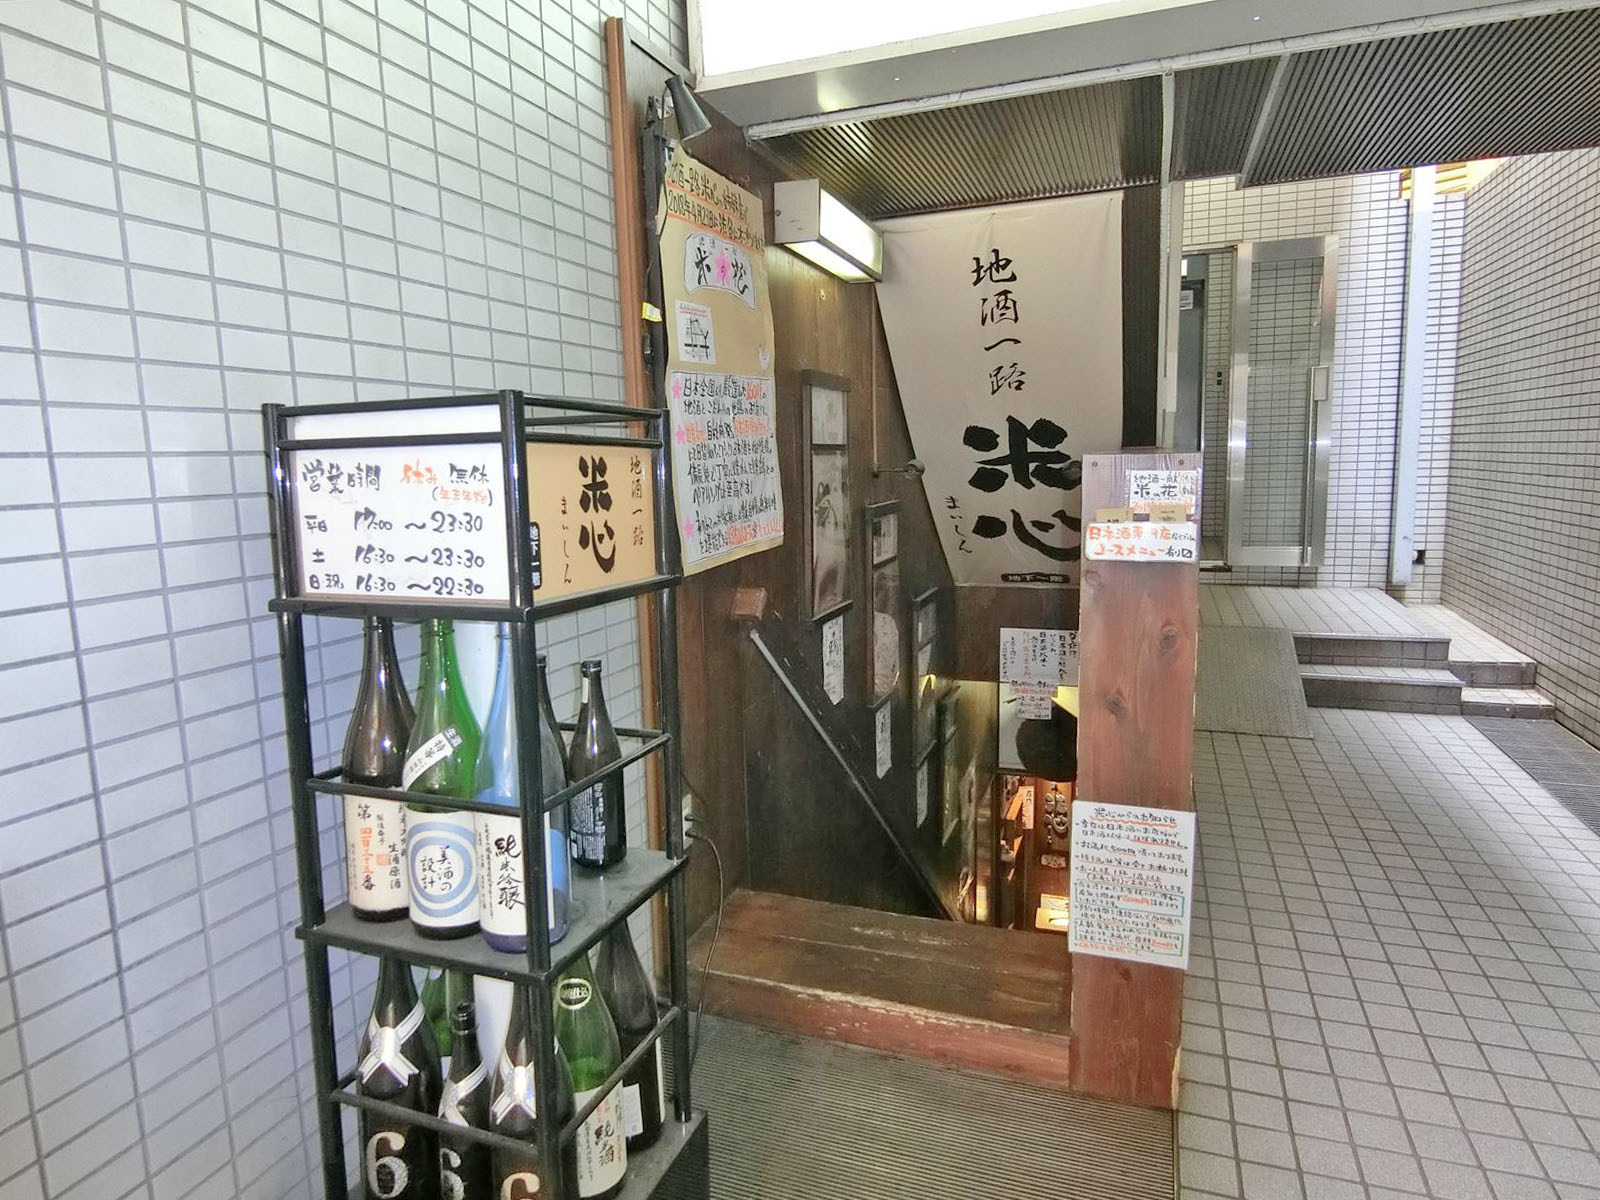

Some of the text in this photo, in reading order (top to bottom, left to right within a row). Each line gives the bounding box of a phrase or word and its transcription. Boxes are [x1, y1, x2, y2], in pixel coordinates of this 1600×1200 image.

[971, 248, 1026, 396] 地酒一路
[302, 458, 381, 495] 営業時間
[449, 463, 490, 484] 無休
[629, 455, 645, 546] 地酒一路
[962, 414, 1081, 561] 米心
[1133, 483, 1178, 498] 米の花
[560, 496, 572, 584] まいしん
[578, 454, 616, 574] 米心
[944, 495, 974, 554] まいしん
[312, 547, 326, 564] 土
[420, 856, 436, 890] 設計
[365, 1131, 409, 1200] 6
